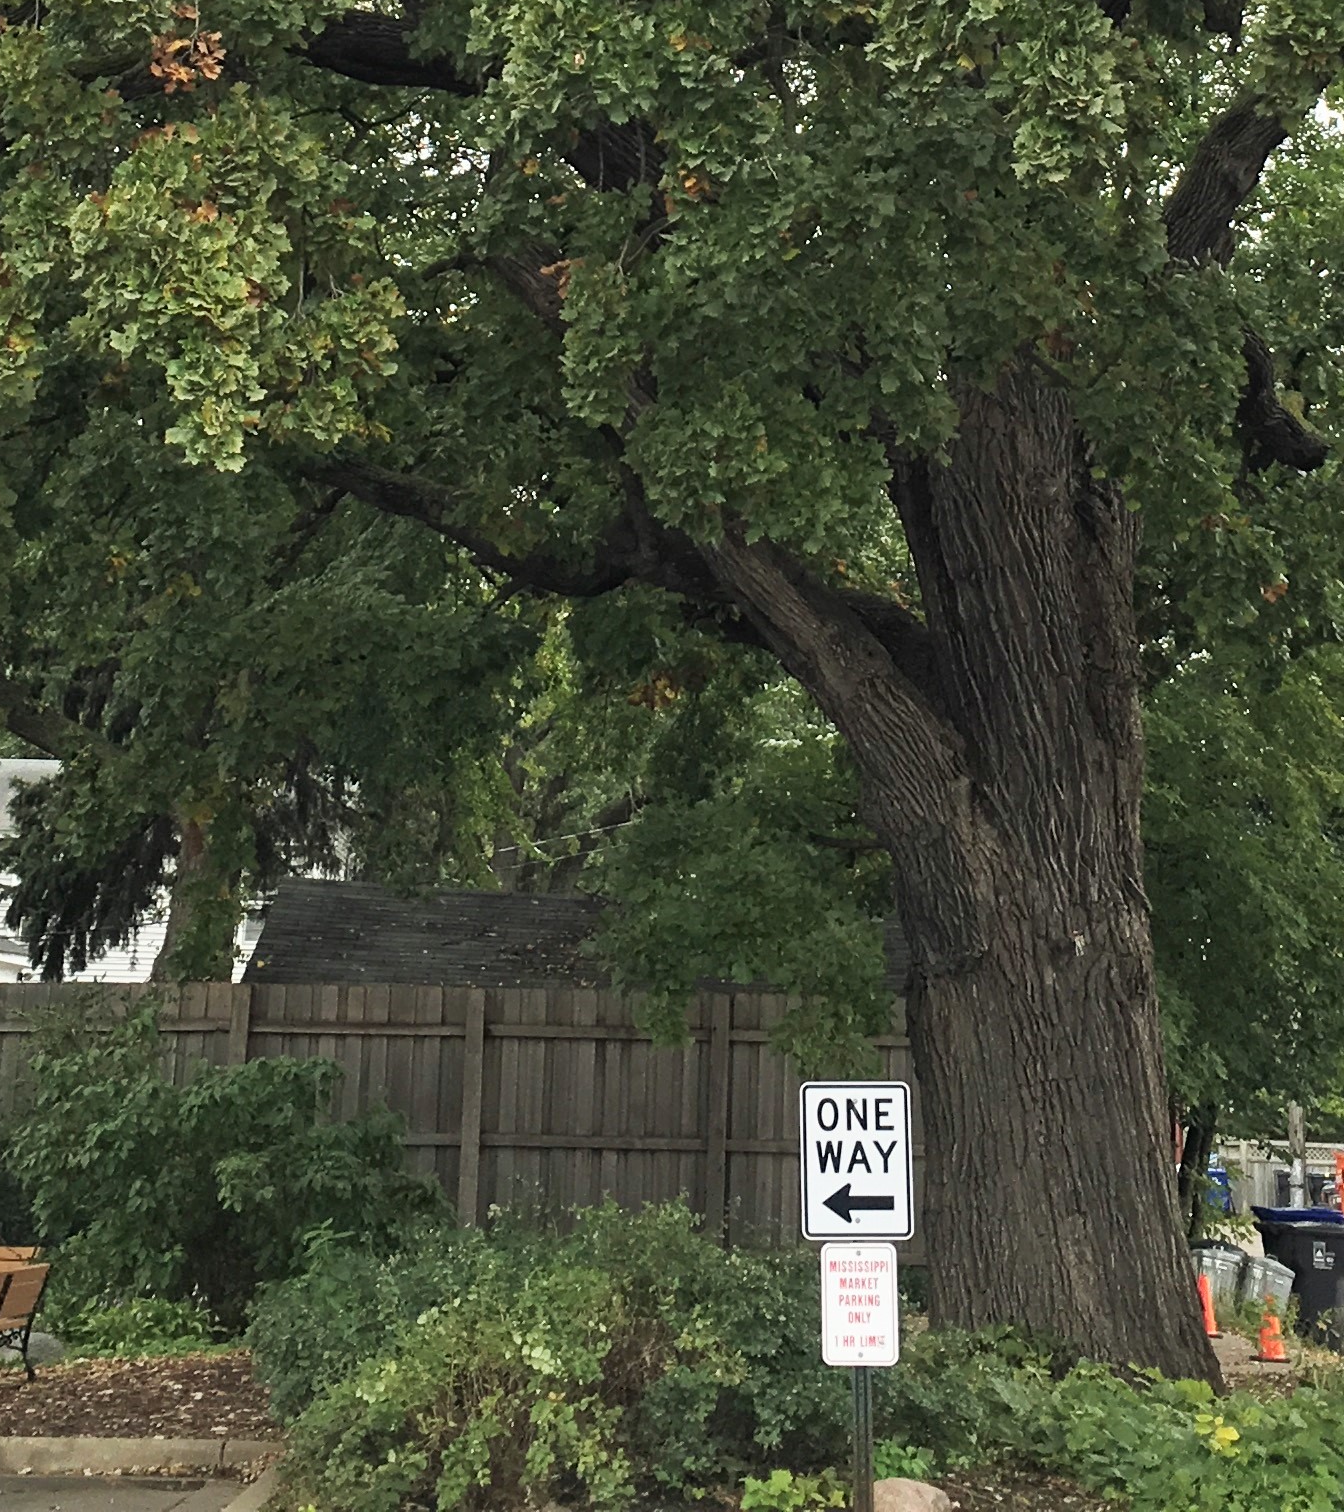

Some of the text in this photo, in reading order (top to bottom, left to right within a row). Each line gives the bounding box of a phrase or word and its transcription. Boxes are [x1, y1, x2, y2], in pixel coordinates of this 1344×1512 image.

[816, 1098, 895, 1131] ONE
[816, 1140, 898, 1174] WAY
[829, 1260, 889, 1272] MISSISSIPPI
[839, 1277, 879, 1289] MARKET
[838, 1294, 881, 1306] PARKING
[848, 1311, 871, 1324] ONLY
[843, 1335, 855, 1347] HR
